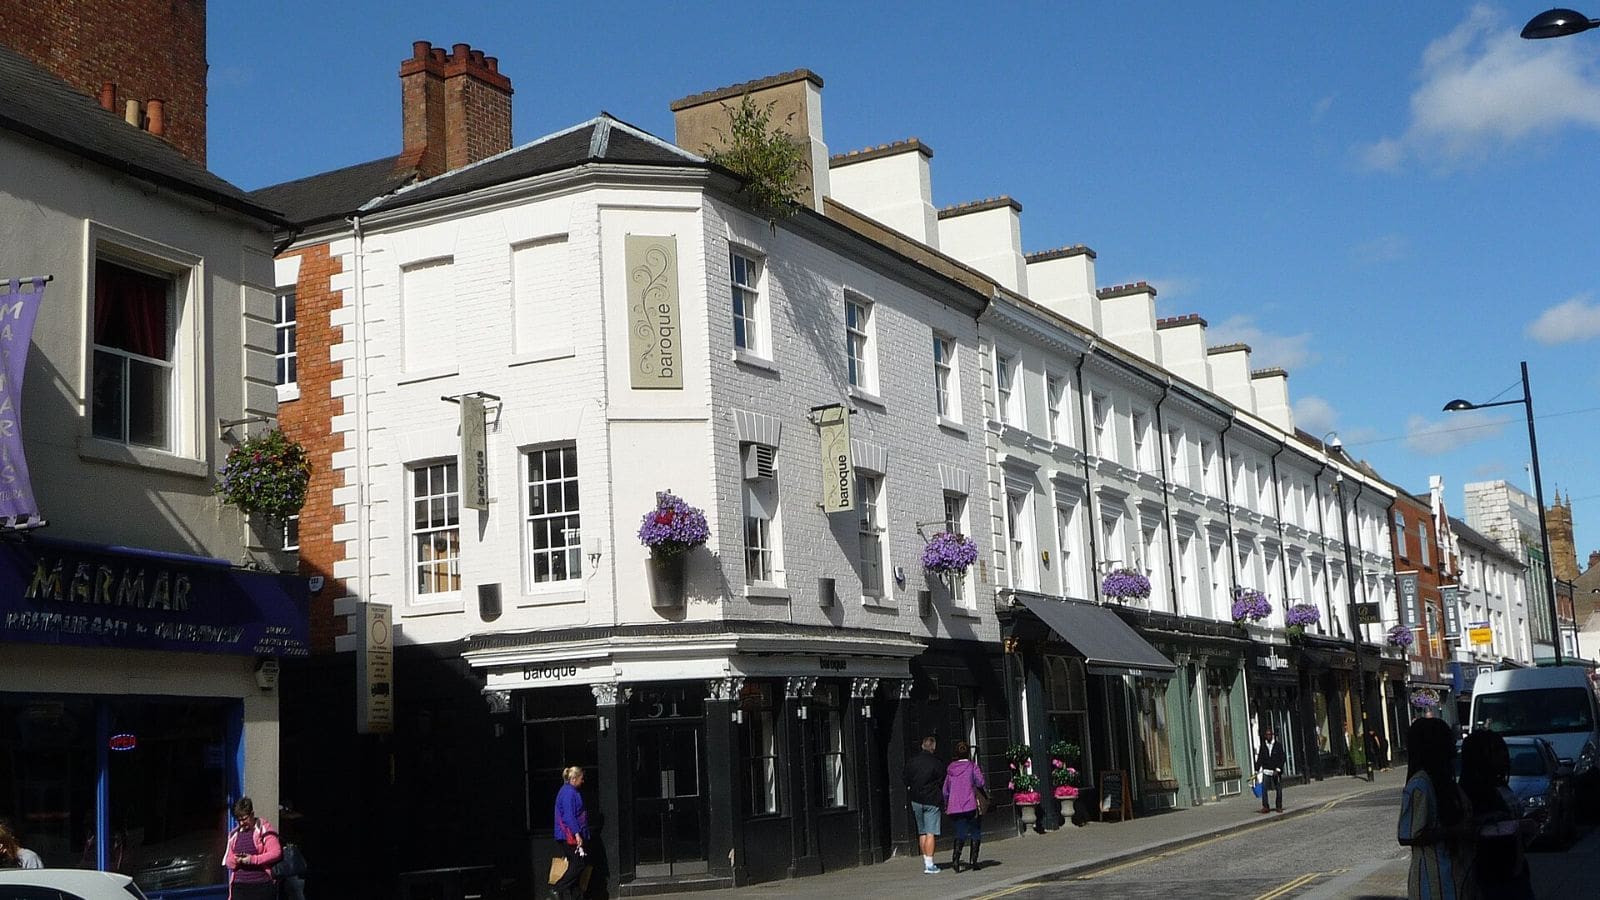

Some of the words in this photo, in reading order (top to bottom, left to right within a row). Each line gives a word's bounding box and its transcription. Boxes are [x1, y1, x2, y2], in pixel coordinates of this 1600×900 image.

[658, 303, 675, 378] baroque
[477, 450, 486, 506] baroque
[838, 454, 850, 507] baroque
[523, 664, 577, 681] baroque
[819, 656, 848, 672] baroque
